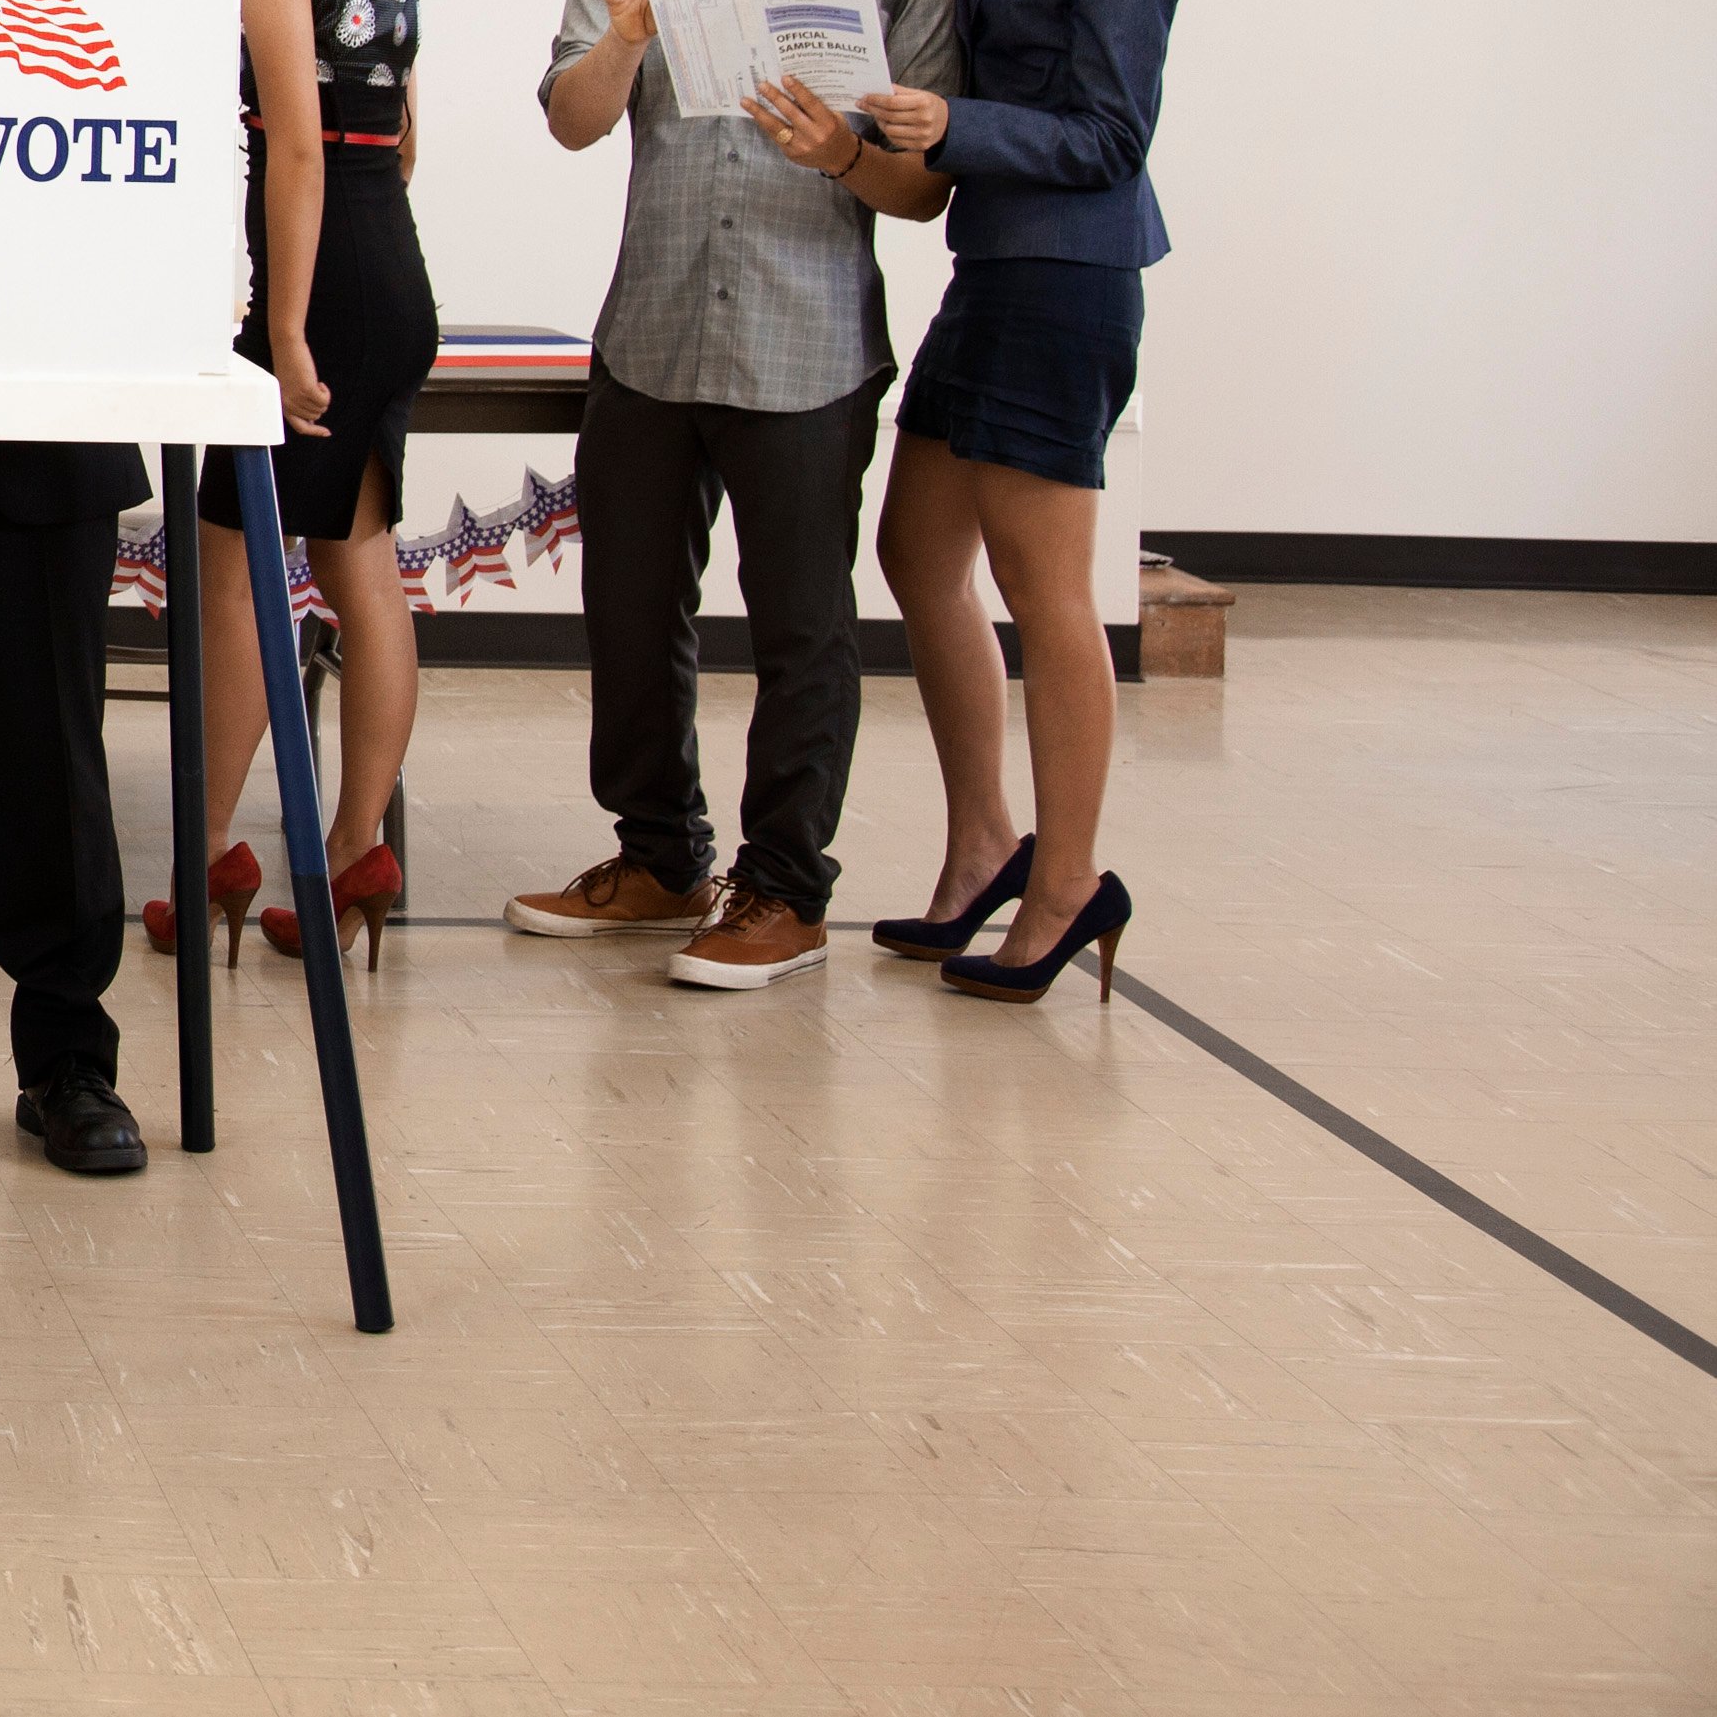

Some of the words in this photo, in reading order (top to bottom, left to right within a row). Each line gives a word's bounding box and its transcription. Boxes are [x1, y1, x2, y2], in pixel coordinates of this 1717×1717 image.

[776, 31, 828, 43] OFFICIAL
[779, 41, 824, 54] SAMPLE
[827, 42, 868, 54] BALLOT
[781, 53, 795, 62] and
